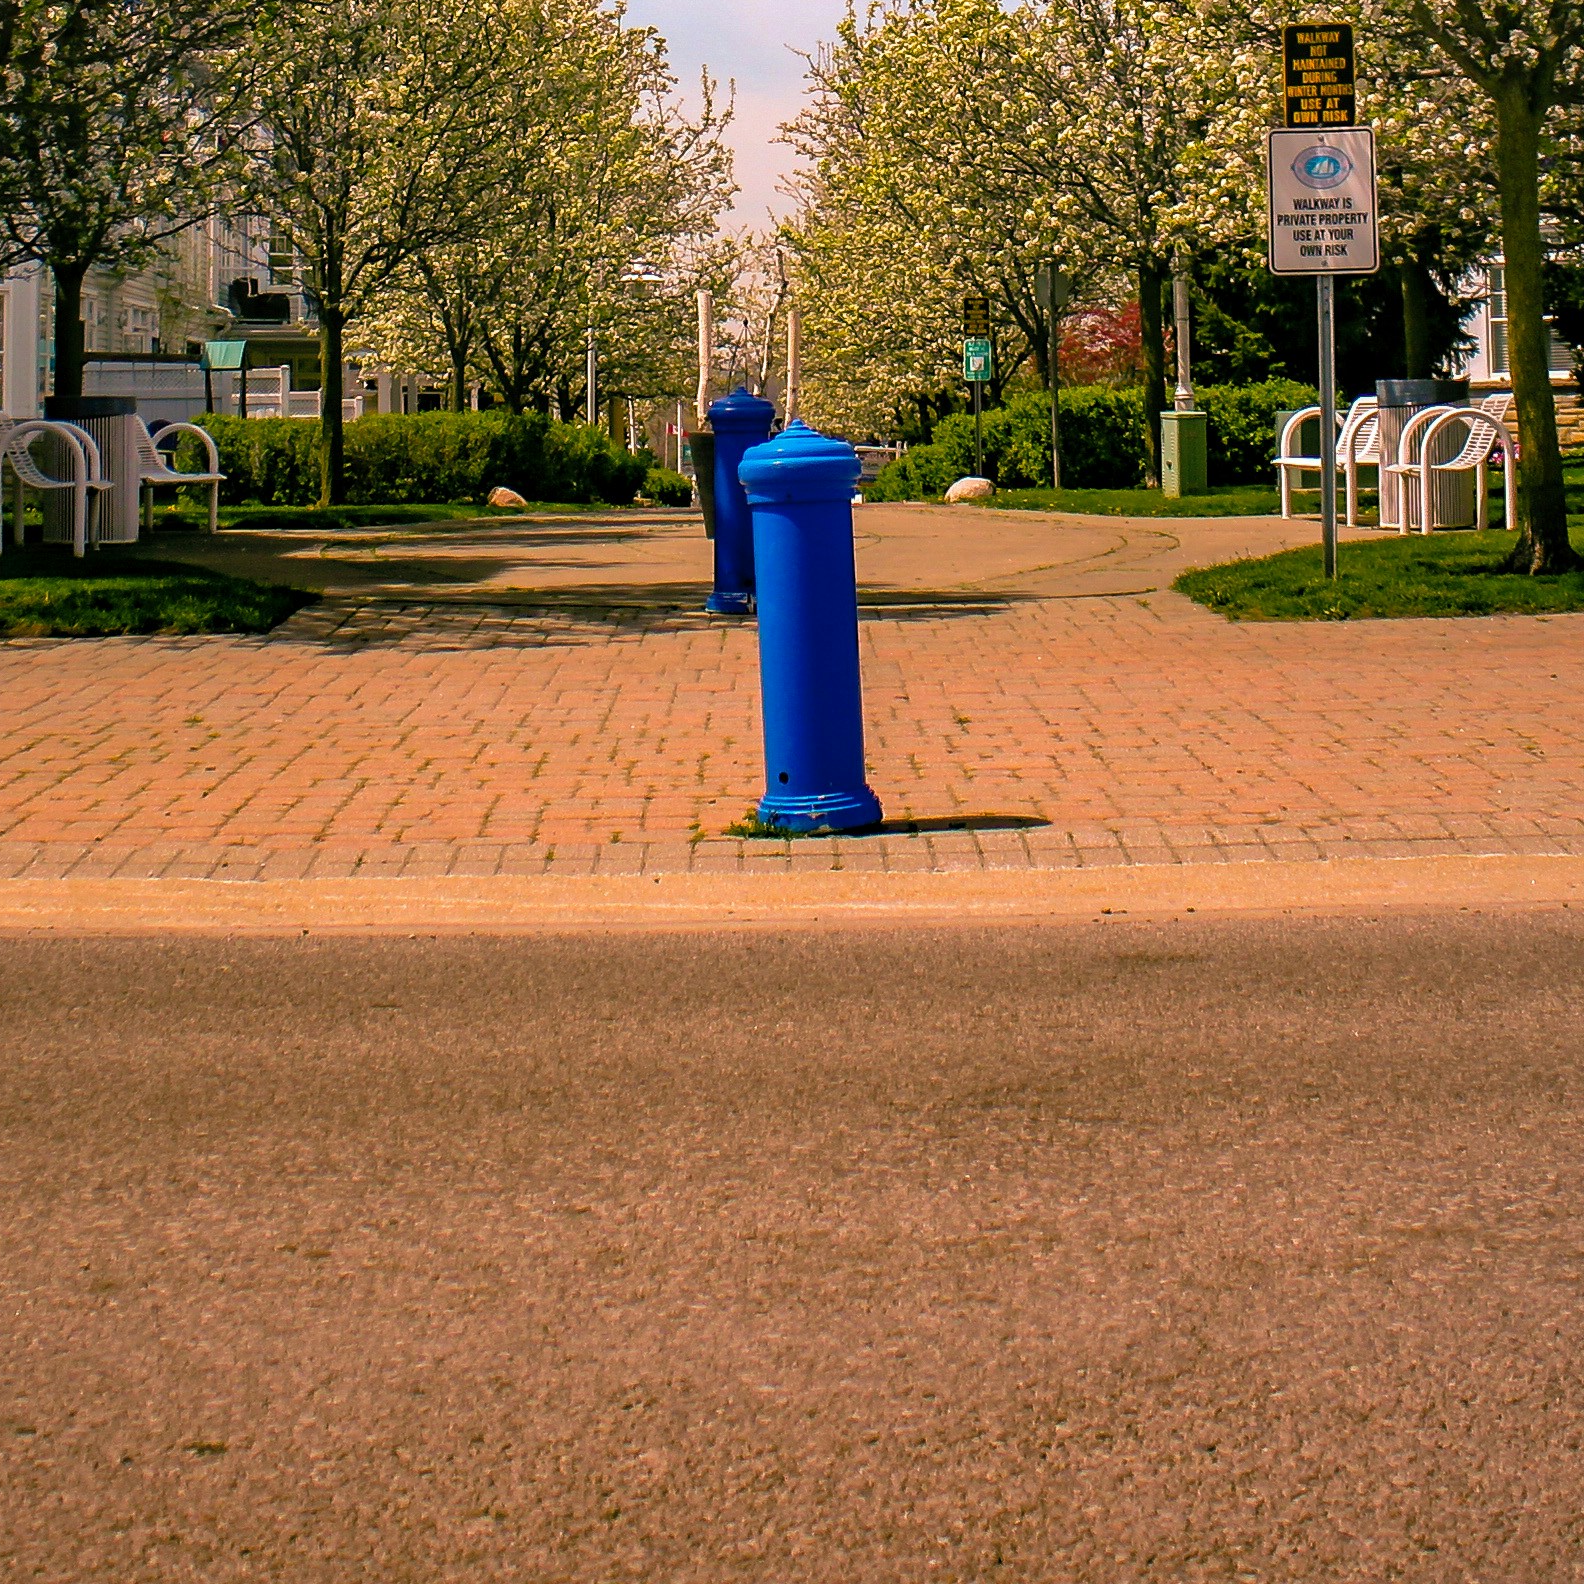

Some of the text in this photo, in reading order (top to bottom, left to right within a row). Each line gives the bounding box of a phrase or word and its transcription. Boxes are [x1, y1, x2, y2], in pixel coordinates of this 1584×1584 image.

[1297, 32, 1340, 44] WALKWAY
[1310, 45, 1327, 57] NOT
[1293, 58, 1346, 70] MAINTAINED
[1302, 71, 1337, 83] DURING
[1287, 84, 1353, 97] WINTER MONTHS
[1301, 97, 1340, 110] USE AT
[1293, 110, 1348, 123] OWN RISK
[1293, 197, 1353, 210] WALKWAY IS
[1277, 212, 1368, 226] PRIVATE PROPERTY
[1293, 228, 1354, 241] USE AT YOUR
[1300, 244, 1348, 256] OWN RISK
